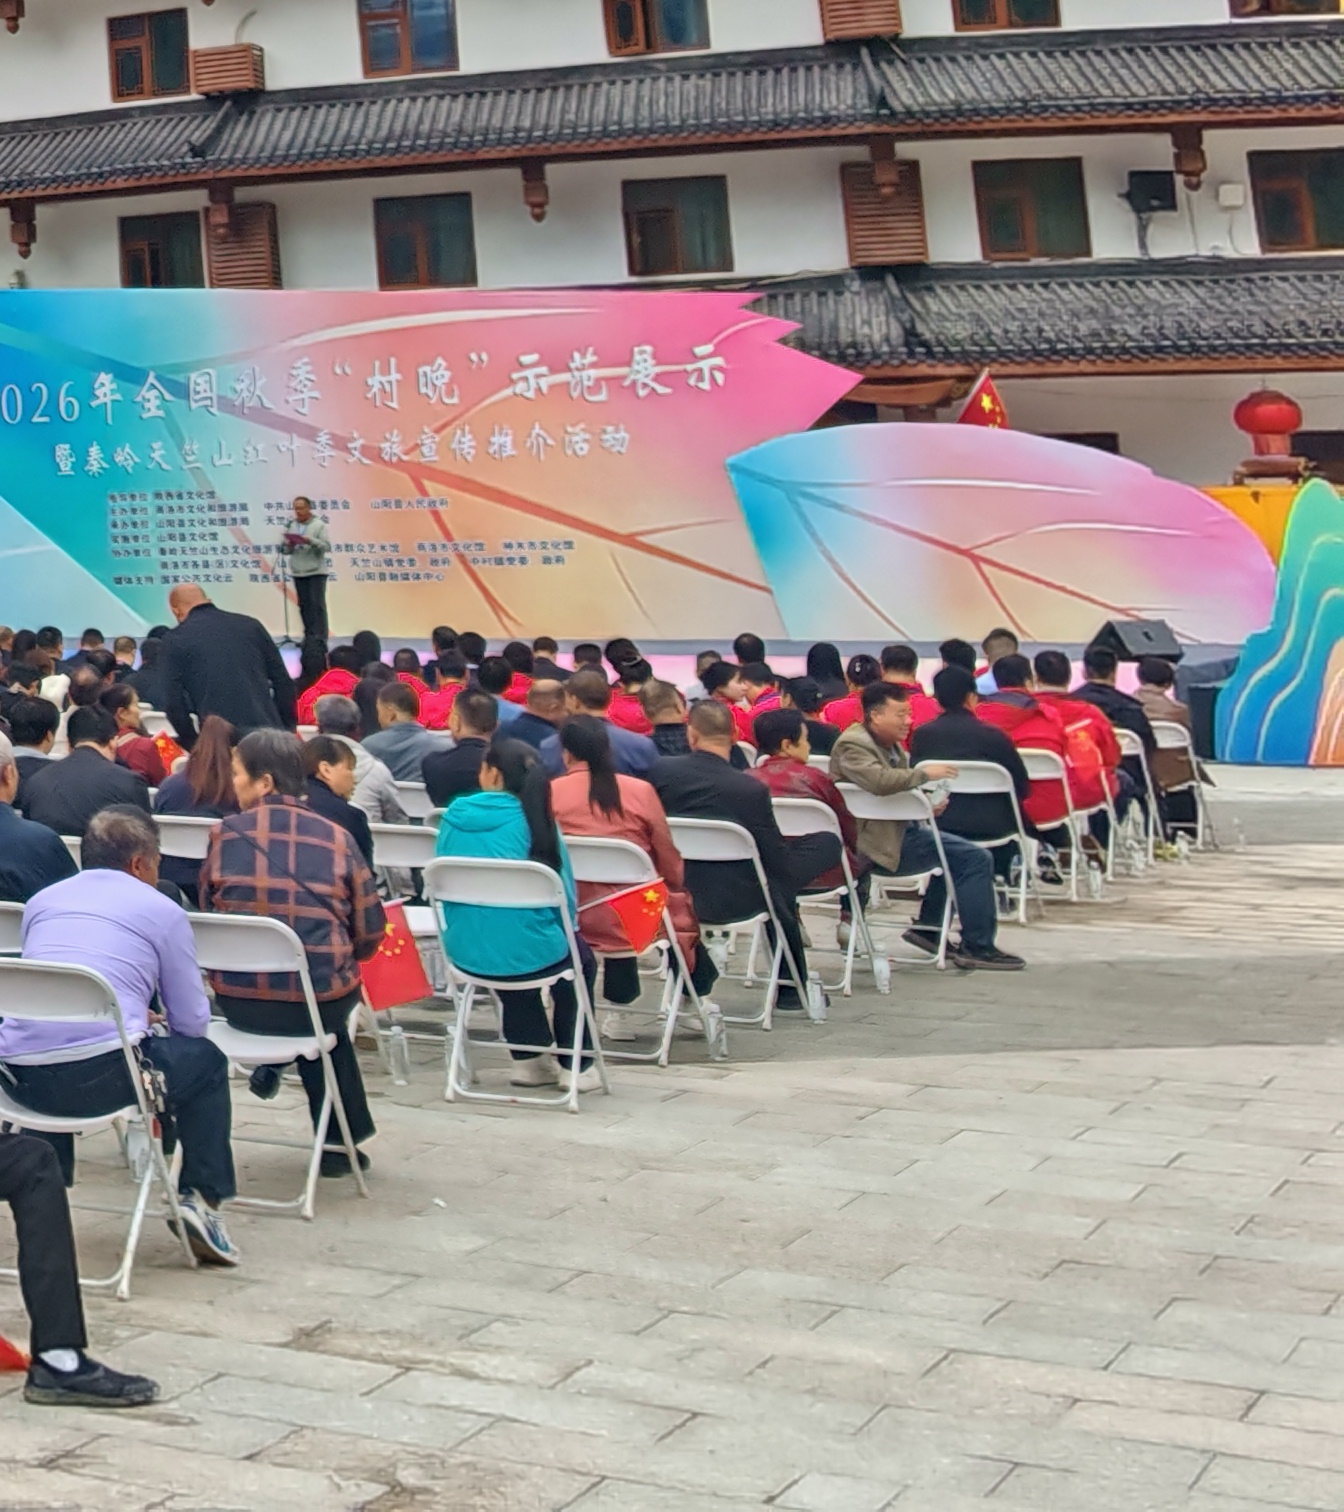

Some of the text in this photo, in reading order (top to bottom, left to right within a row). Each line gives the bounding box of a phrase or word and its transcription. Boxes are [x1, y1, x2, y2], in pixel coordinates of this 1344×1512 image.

[54, 423, 630, 478] 暨秦岭天竺山红叶季文旅宣传推介活动
[264, 499, 351, 511] 中共山县委员会
